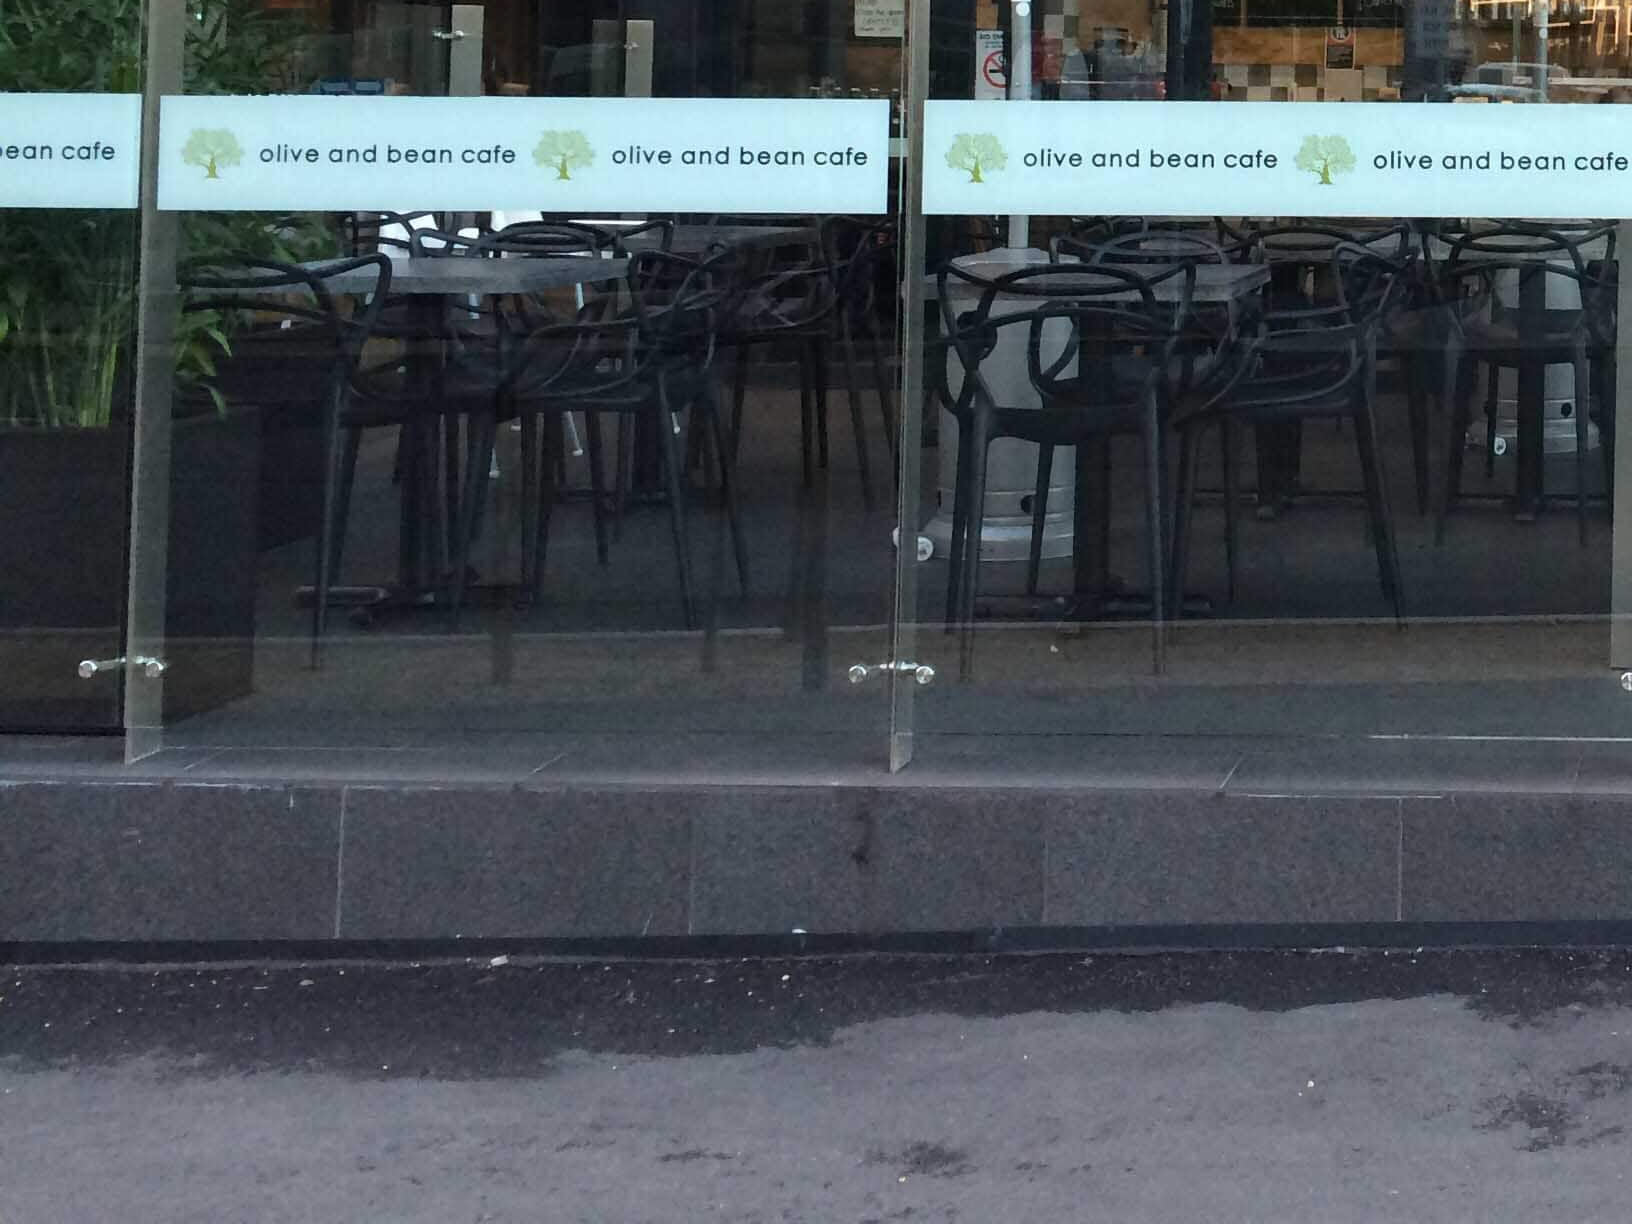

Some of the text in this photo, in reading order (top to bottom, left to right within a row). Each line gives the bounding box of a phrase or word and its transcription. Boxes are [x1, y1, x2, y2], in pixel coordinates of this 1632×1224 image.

[0, 140, 116, 161] ean cafe
[260, 144, 516, 164] olive and bean cafe
[612, 145, 868, 166] olive and bean cafe
[1023, 148, 1278, 169] olive and bean cafe
[1373, 150, 1629, 171] olive and bean cafe
